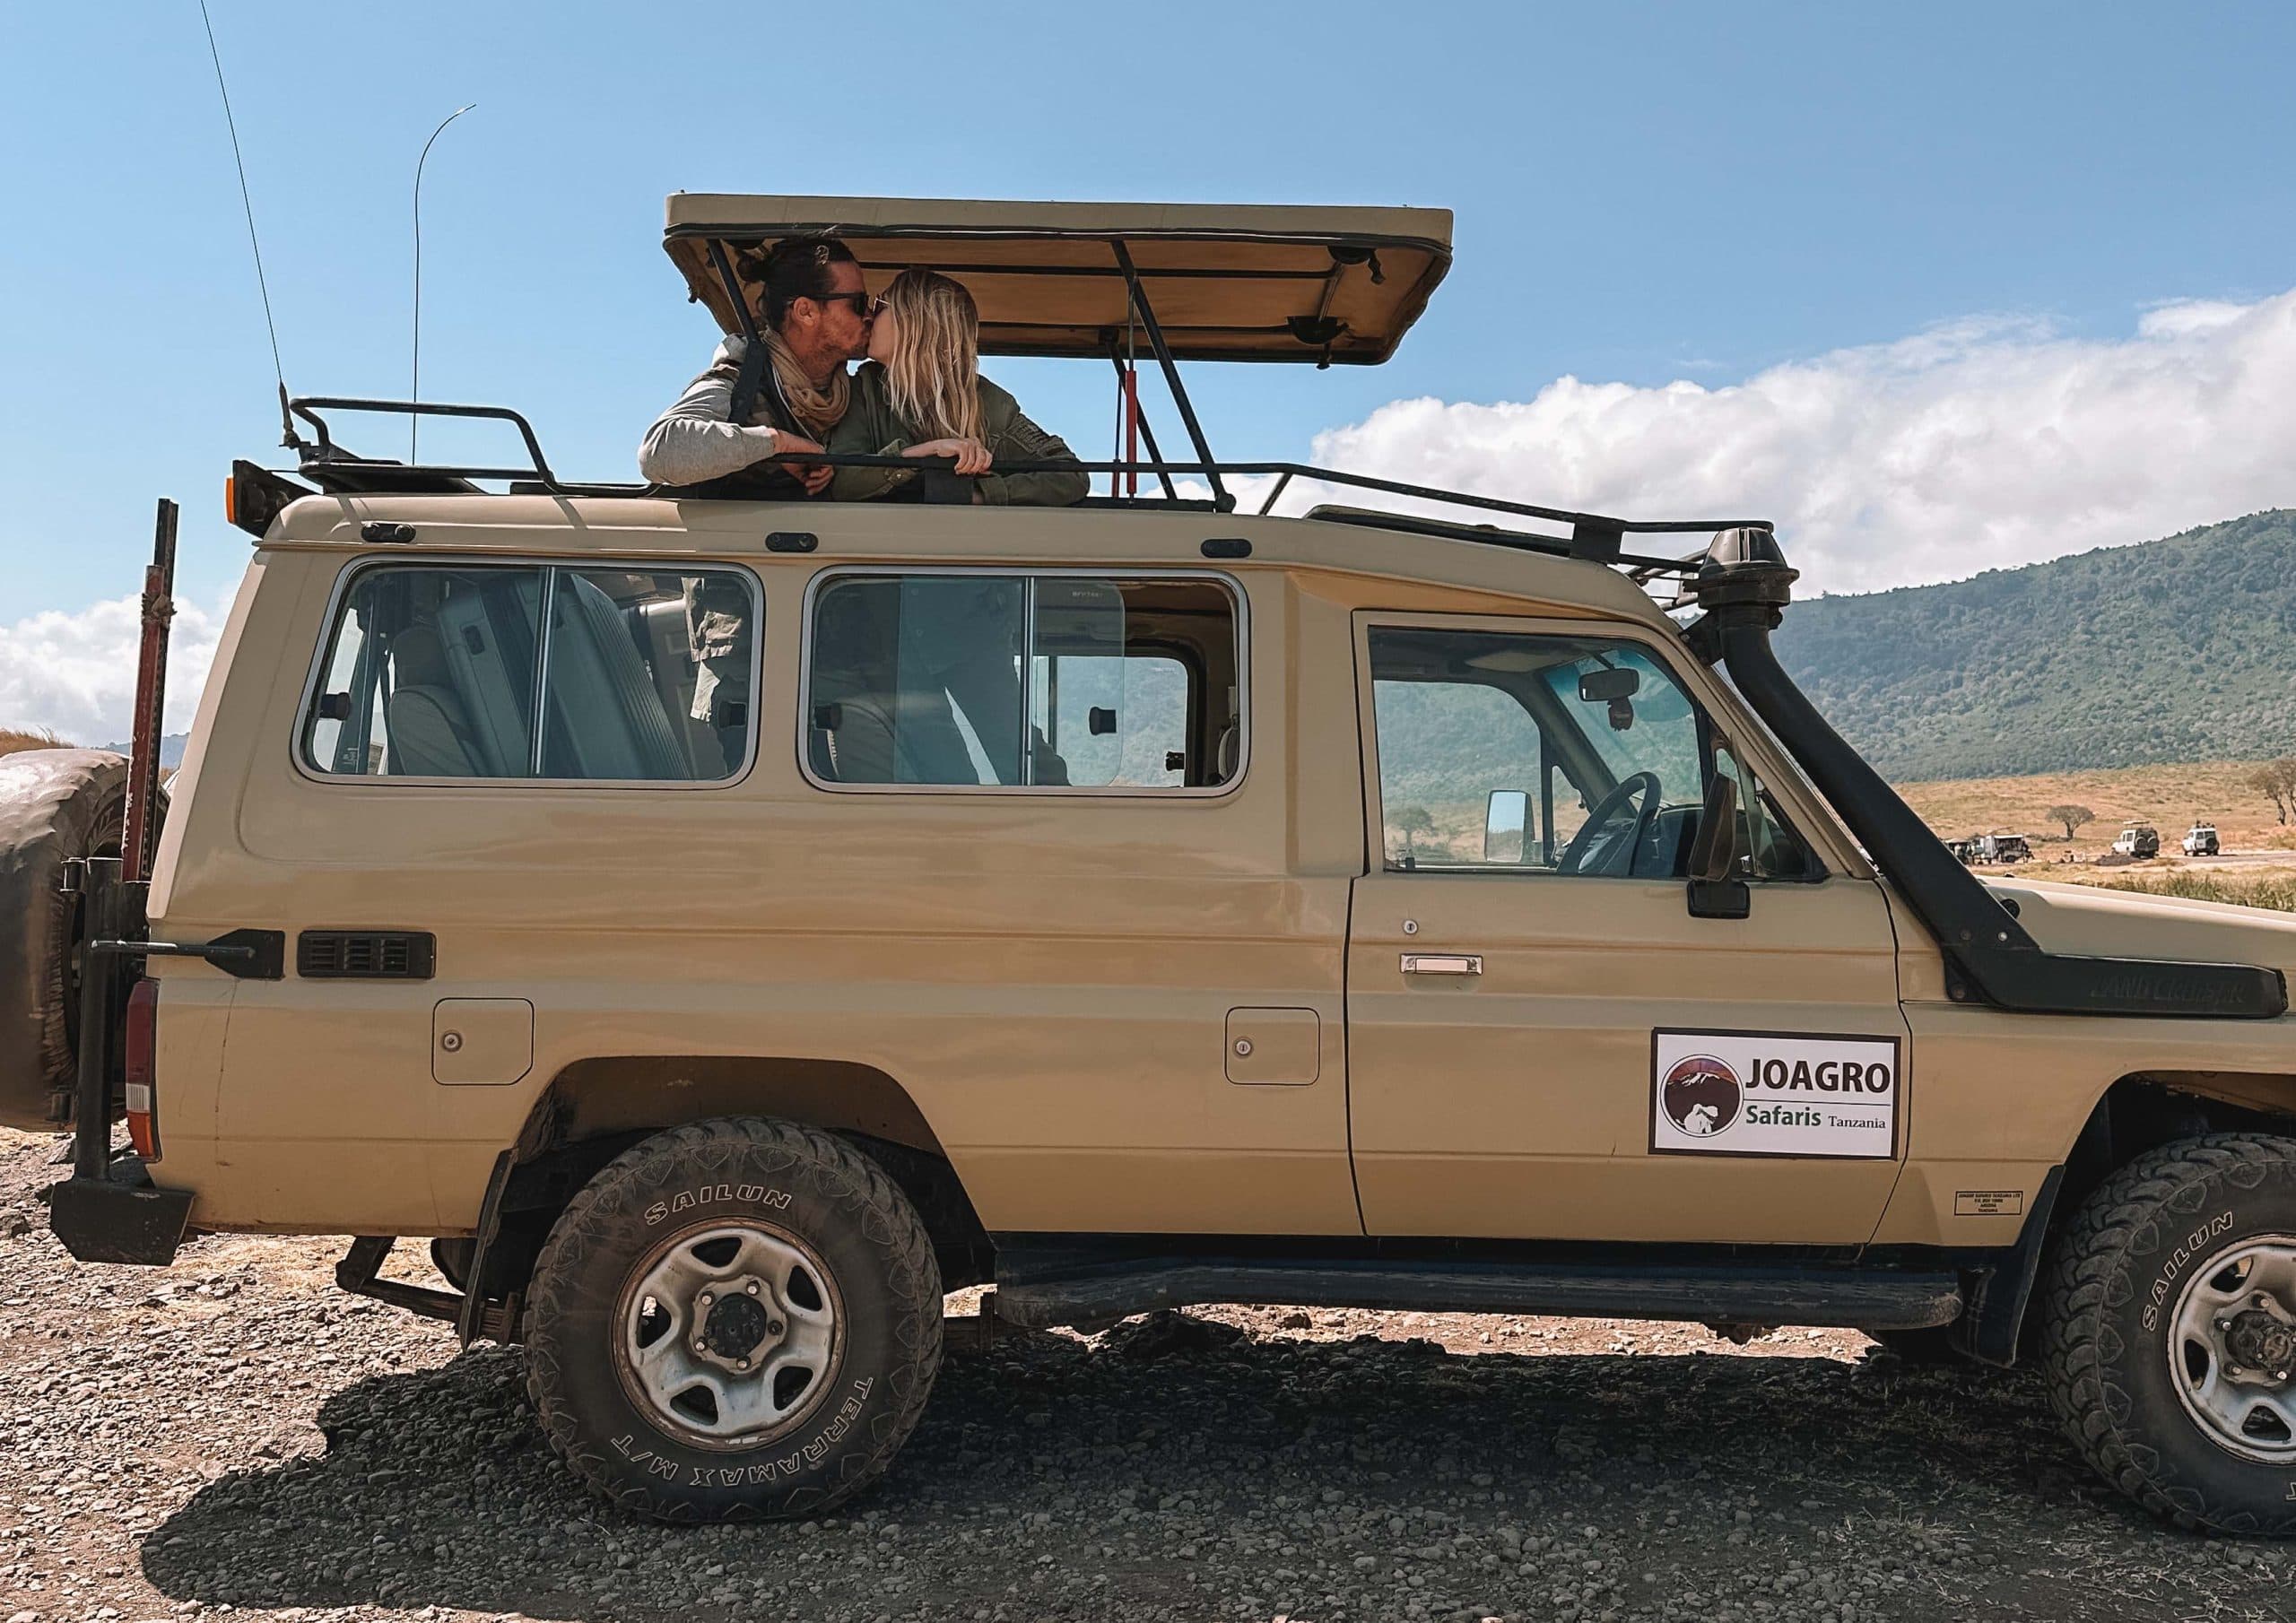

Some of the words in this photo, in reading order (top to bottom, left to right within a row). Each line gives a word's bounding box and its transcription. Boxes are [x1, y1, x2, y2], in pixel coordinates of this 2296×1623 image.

[1745, 1058, 1892, 1093] JOAGRO
[1745, 1105, 1822, 1127] Safaris
[1828, 1115, 1886, 1129] Tanzania
[644, 1184, 792, 1226] SAILUN
[2142, 1211, 2233, 1332] SAILUN
[689, 1376, 874, 1488] TERRAMAX
[611, 1435, 679, 1480] M/T
